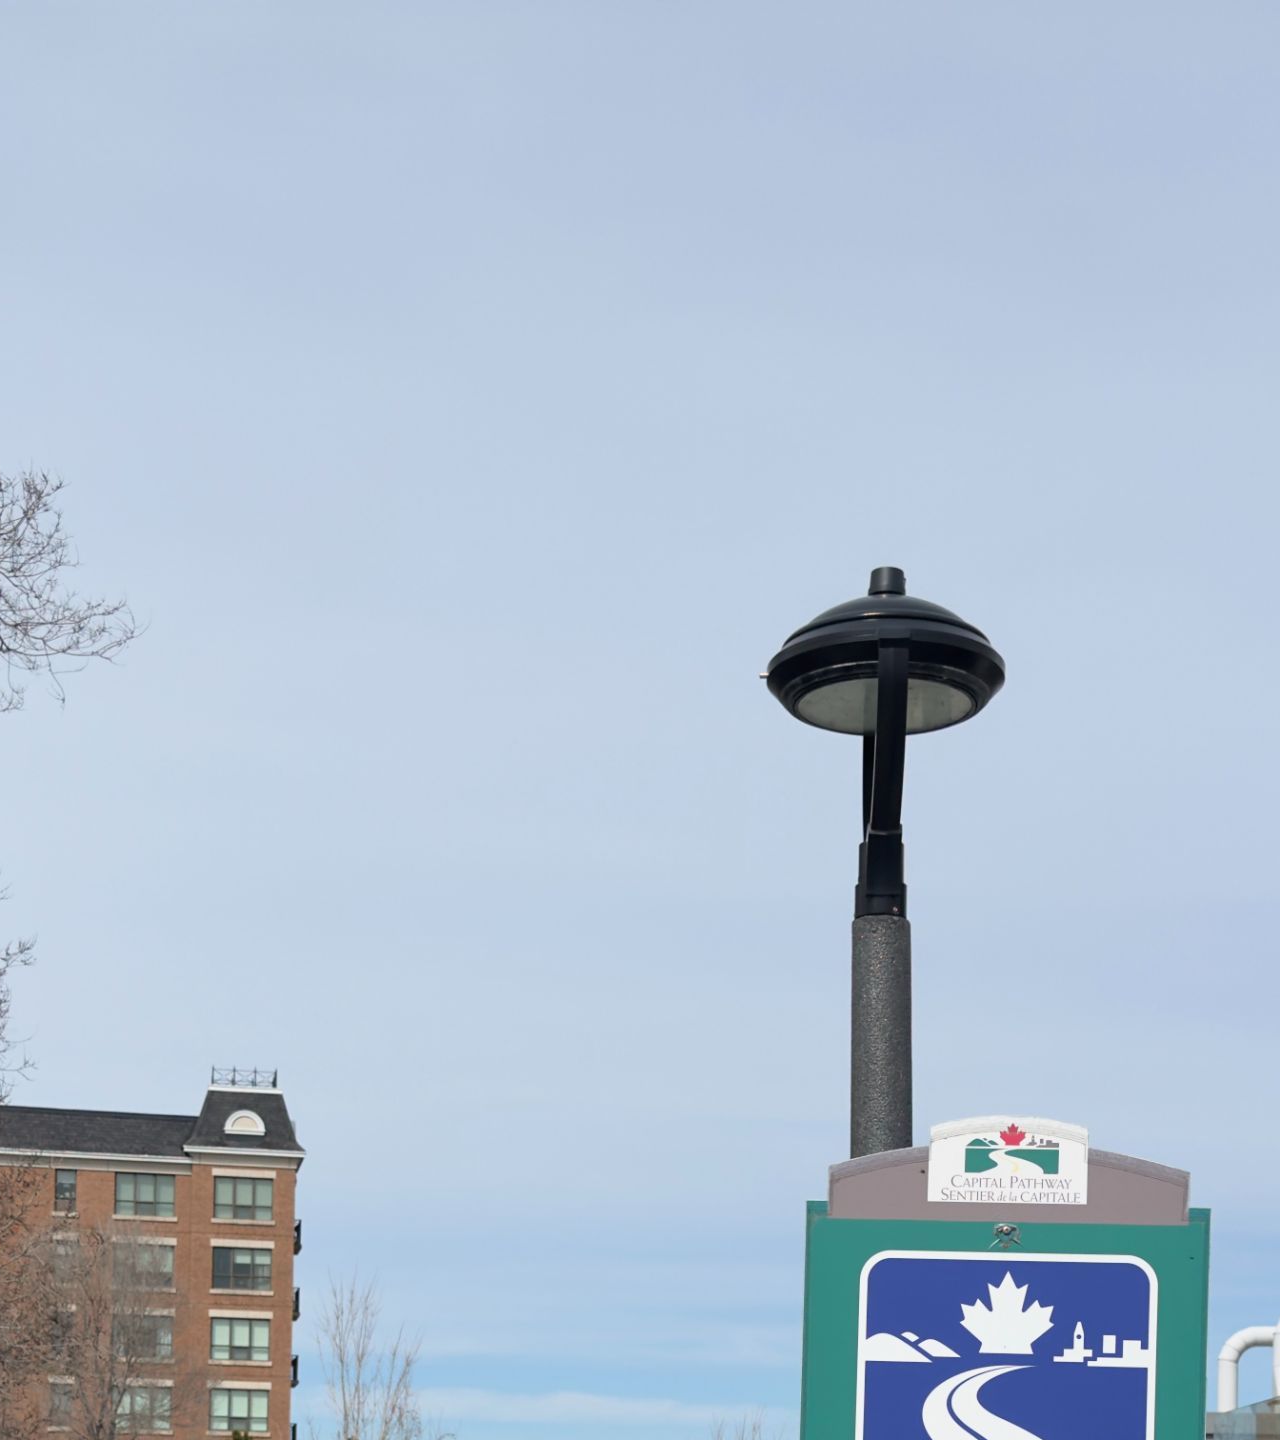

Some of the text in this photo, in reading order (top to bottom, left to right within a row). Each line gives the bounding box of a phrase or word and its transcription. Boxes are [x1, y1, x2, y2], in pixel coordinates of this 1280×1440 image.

[950, 1174, 1072, 1190] CAPITAL PATHWAY
[940, 1188, 995, 1202] SENTIER
[1020, 1191, 1081, 1204] CAPITALE
